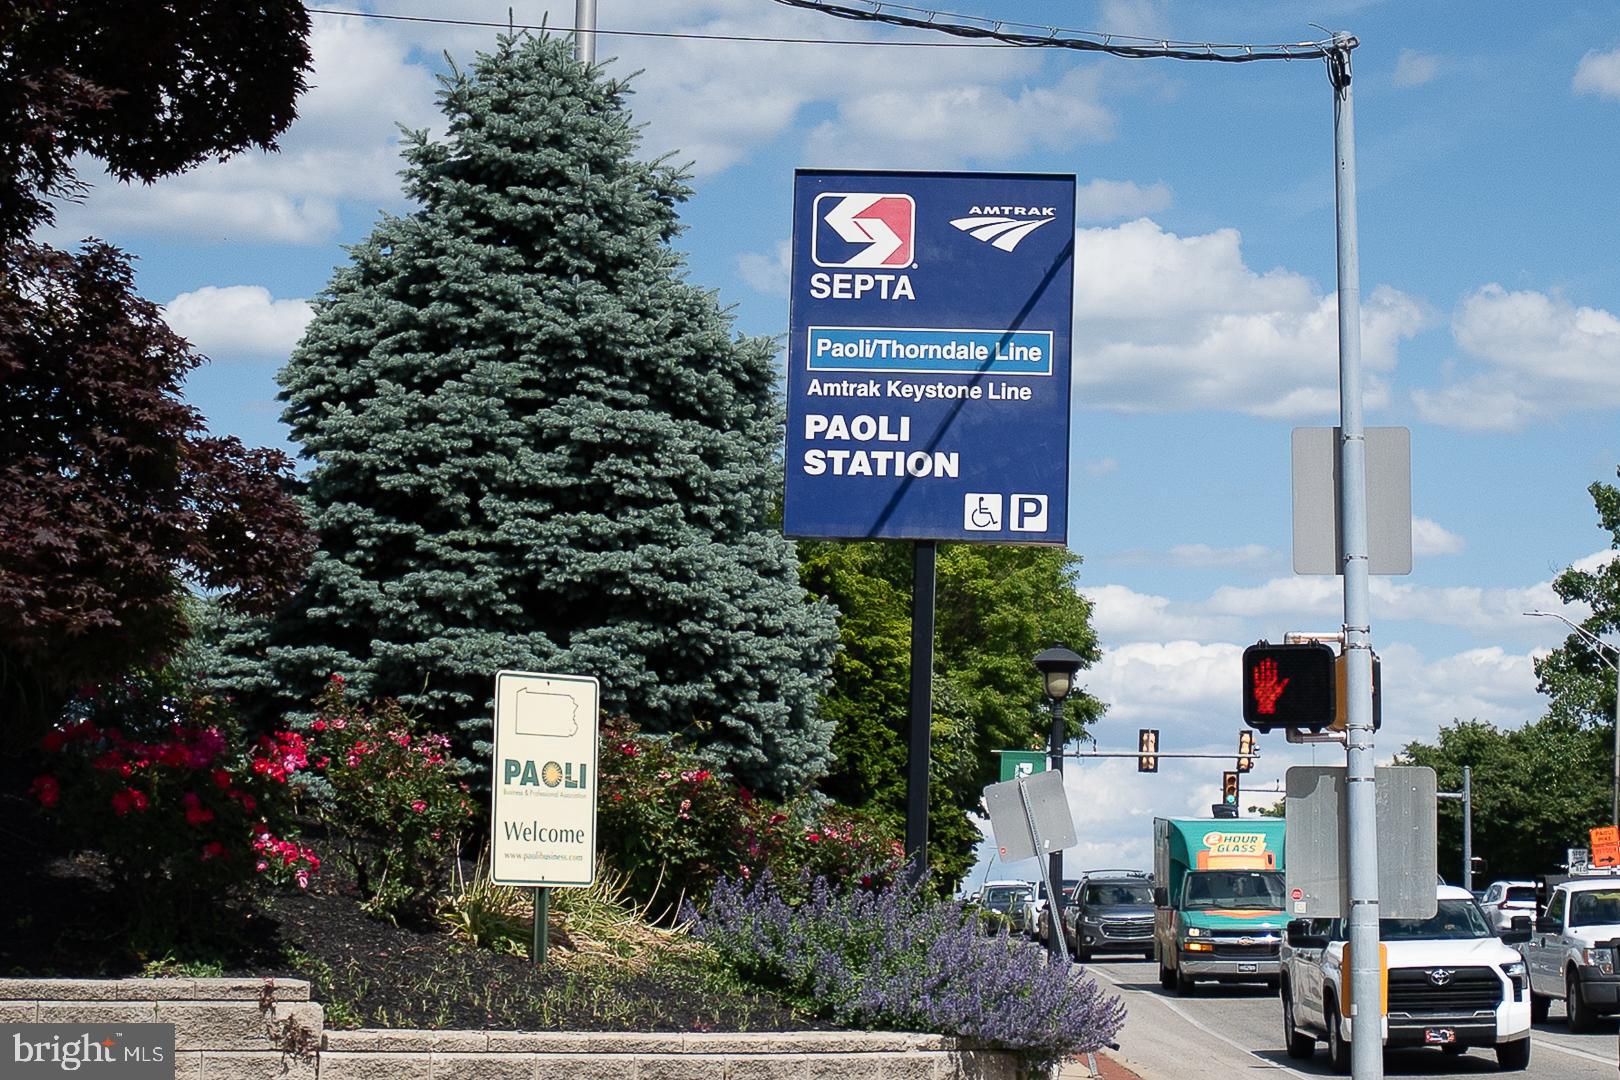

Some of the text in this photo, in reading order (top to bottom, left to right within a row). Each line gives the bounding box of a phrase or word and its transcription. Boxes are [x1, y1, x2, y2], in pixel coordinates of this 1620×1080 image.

[969, 206, 1055, 216] AMTRAK
[810, 273, 915, 300] SEPTA
[816, 338, 1042, 362] Paoli/Thorndale Line
[807, 378, 1032, 402] Amtrak Keystone Line
[805, 414, 910, 442] PAOLI
[803, 449, 959, 478] STATION
[1018, 497, 1043, 529] P
[504, 758, 587, 789] PAOLI
[504, 820, 585, 844] Welcome
[1223, 835, 1258, 844] HOUR
[1217, 844, 1257, 852] GLASS
